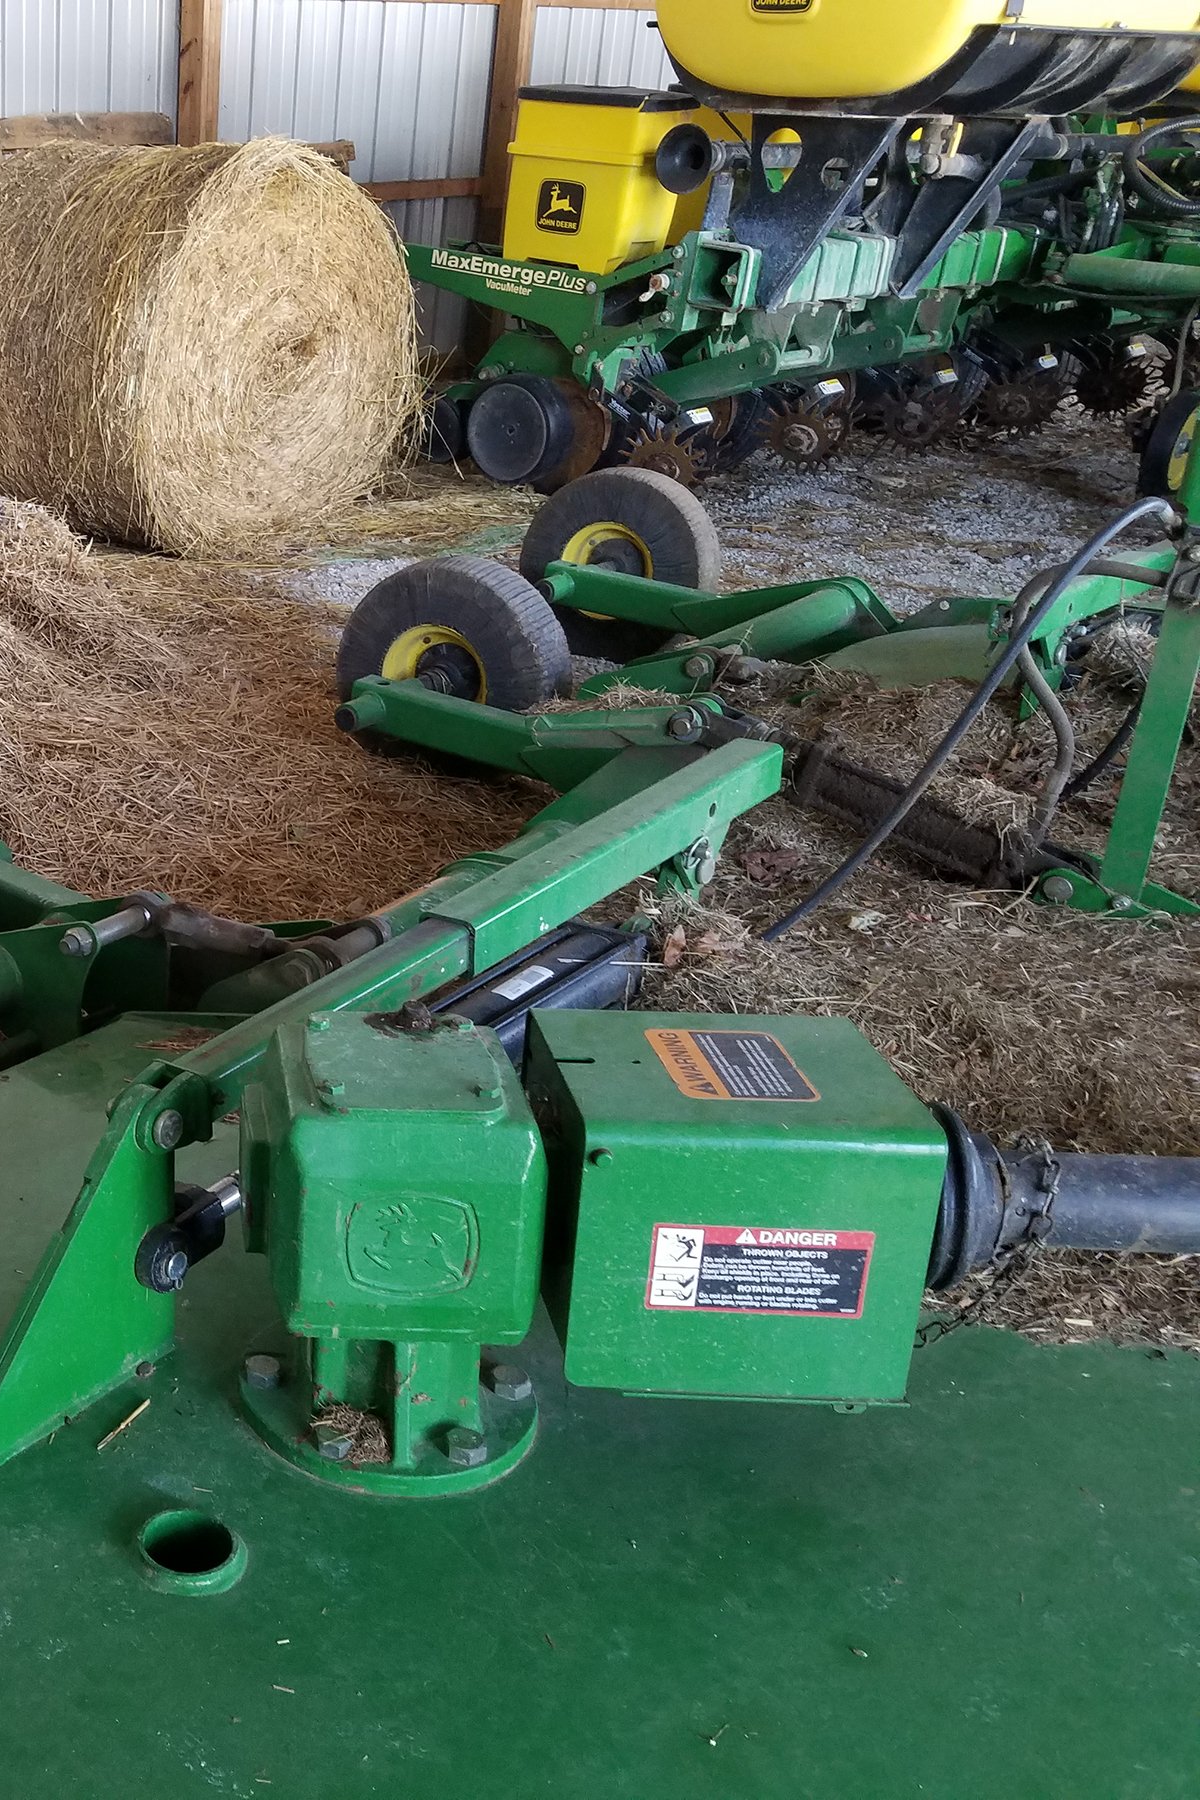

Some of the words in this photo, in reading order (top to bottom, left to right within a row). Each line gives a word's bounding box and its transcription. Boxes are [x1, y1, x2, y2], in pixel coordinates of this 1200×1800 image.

[538, 218, 556, 226] JOHN
[556, 220, 578, 230] DEERE
[486, 278, 532, 296] VacuMeter
[658, 1032, 707, 1083] WARNING
[759, 1231, 838, 1246] DANGER
[742, 1248, 784, 1257] THROWN
[786, 1250, 828, 1258] OBJECTS
[738, 1285, 784, 1293] ROTATING
